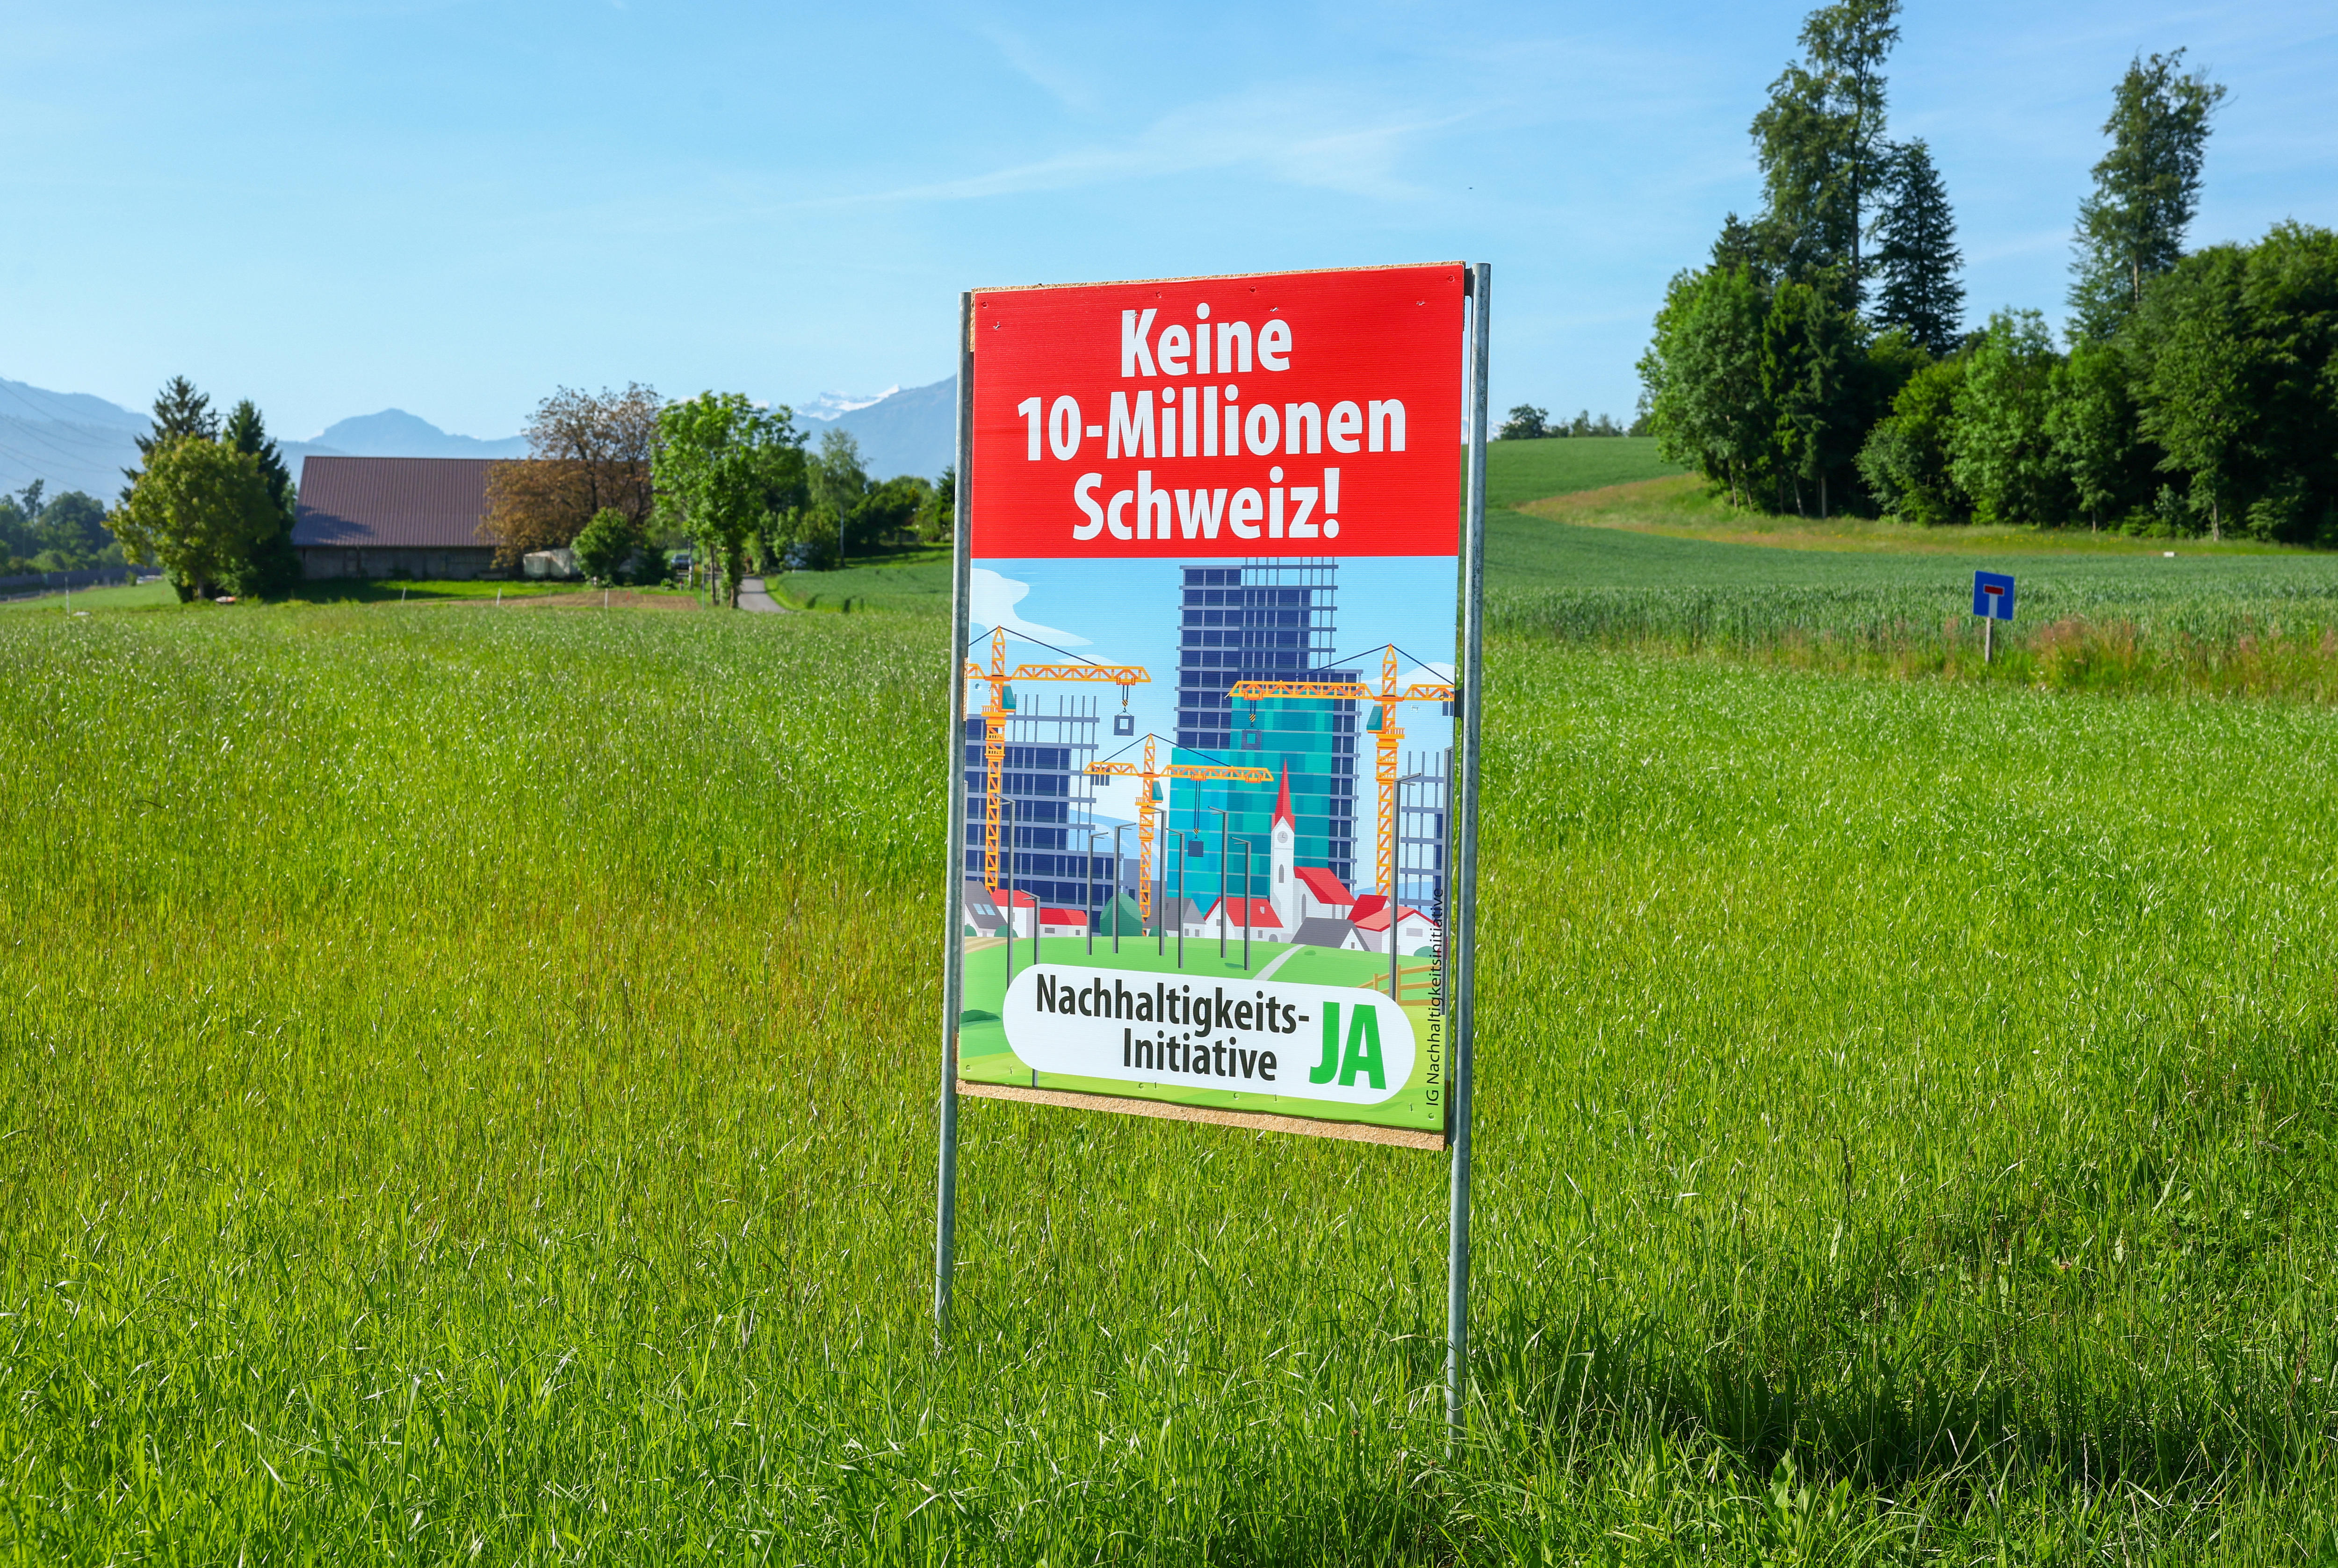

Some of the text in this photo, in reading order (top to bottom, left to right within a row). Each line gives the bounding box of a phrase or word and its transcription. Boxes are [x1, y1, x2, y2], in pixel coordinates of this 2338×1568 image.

[1121, 302, 1292, 378] Keine
[1017, 384, 1406, 461] 10-Millionen
[1072, 466, 1340, 540] Schweiz!
[1036, 973, 1310, 1036] Nachhaltigkeits-
[1426, 888, 1443, 1106] IG Nachhaltigkeitsinitiative
[1124, 1028, 1277, 1081] Initiative
[1309, 1001, 1387, 1090] JA
